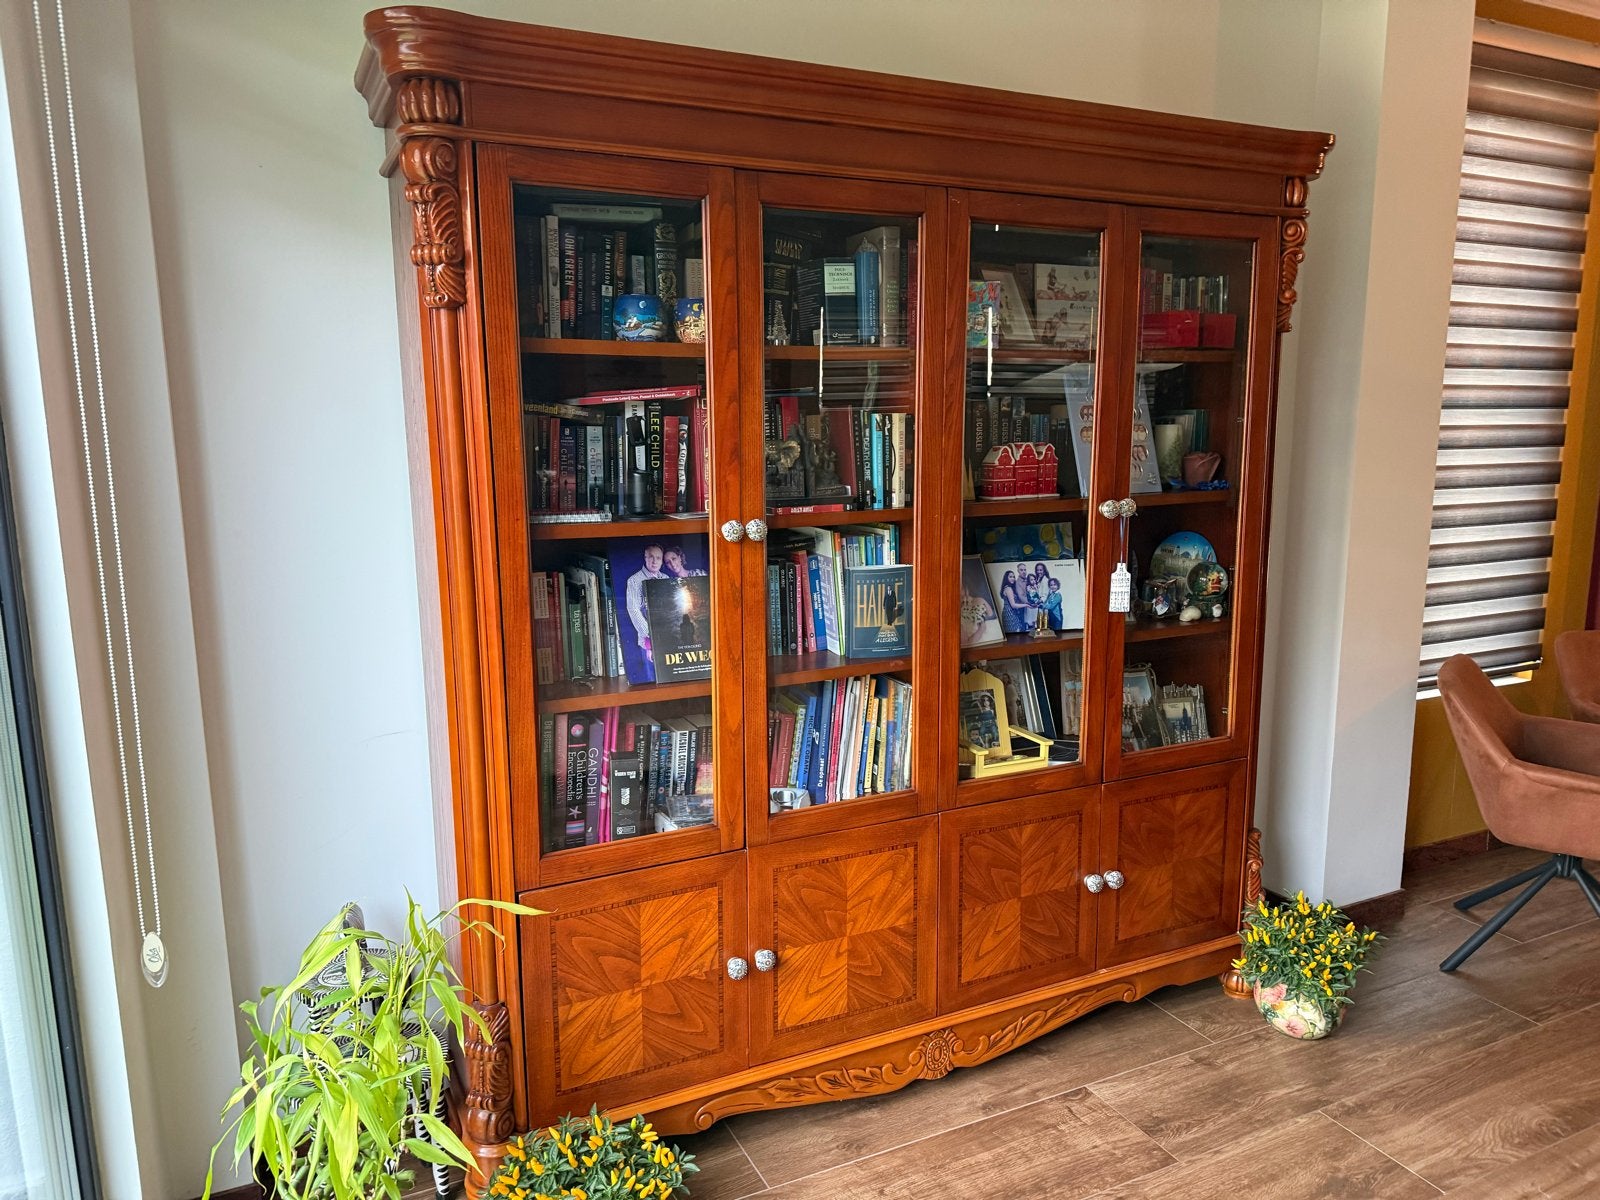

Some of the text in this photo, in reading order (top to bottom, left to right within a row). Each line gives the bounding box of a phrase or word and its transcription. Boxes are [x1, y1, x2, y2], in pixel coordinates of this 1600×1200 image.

[564, 232, 575, 286] JOHN GREEN
[651, 411, 660, 468] LEE CHILD
[863, 461, 871, 481] CURE
[573, 609, 582, 633] tapas
[665, 652, 684, 665] DE
[679, 732, 688, 754] MICHAEL
[803, 715, 814, 775] MICHELLE OBAMA
[567, 751, 576, 801] Encyclopedia
[576, 750, 587, 800] Children's
[586, 747, 599, 799] GANDHI
[817, 779, 824, 788] De
